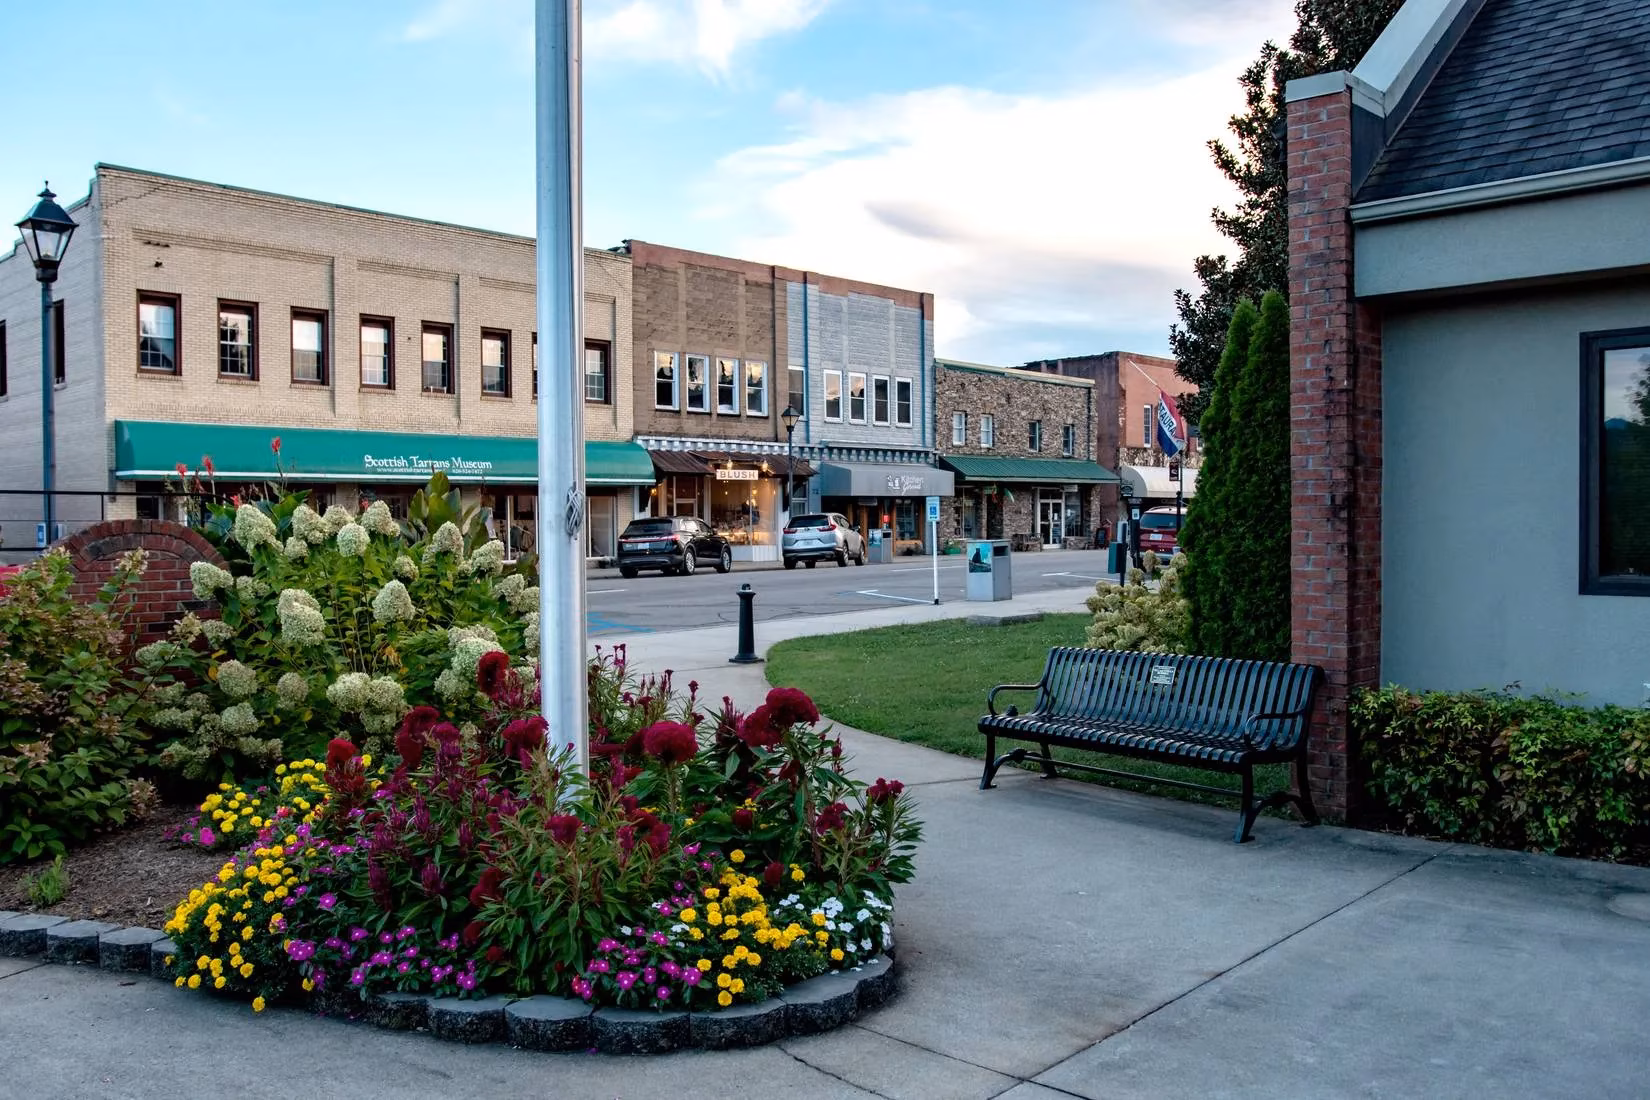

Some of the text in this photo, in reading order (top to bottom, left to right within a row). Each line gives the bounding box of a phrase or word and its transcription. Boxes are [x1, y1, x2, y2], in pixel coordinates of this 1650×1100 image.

[1158, 402, 1177, 438] TAURA
[364, 454, 492, 469] Scottish Tartans Museum
[720, 471, 756, 479] BLUSH
